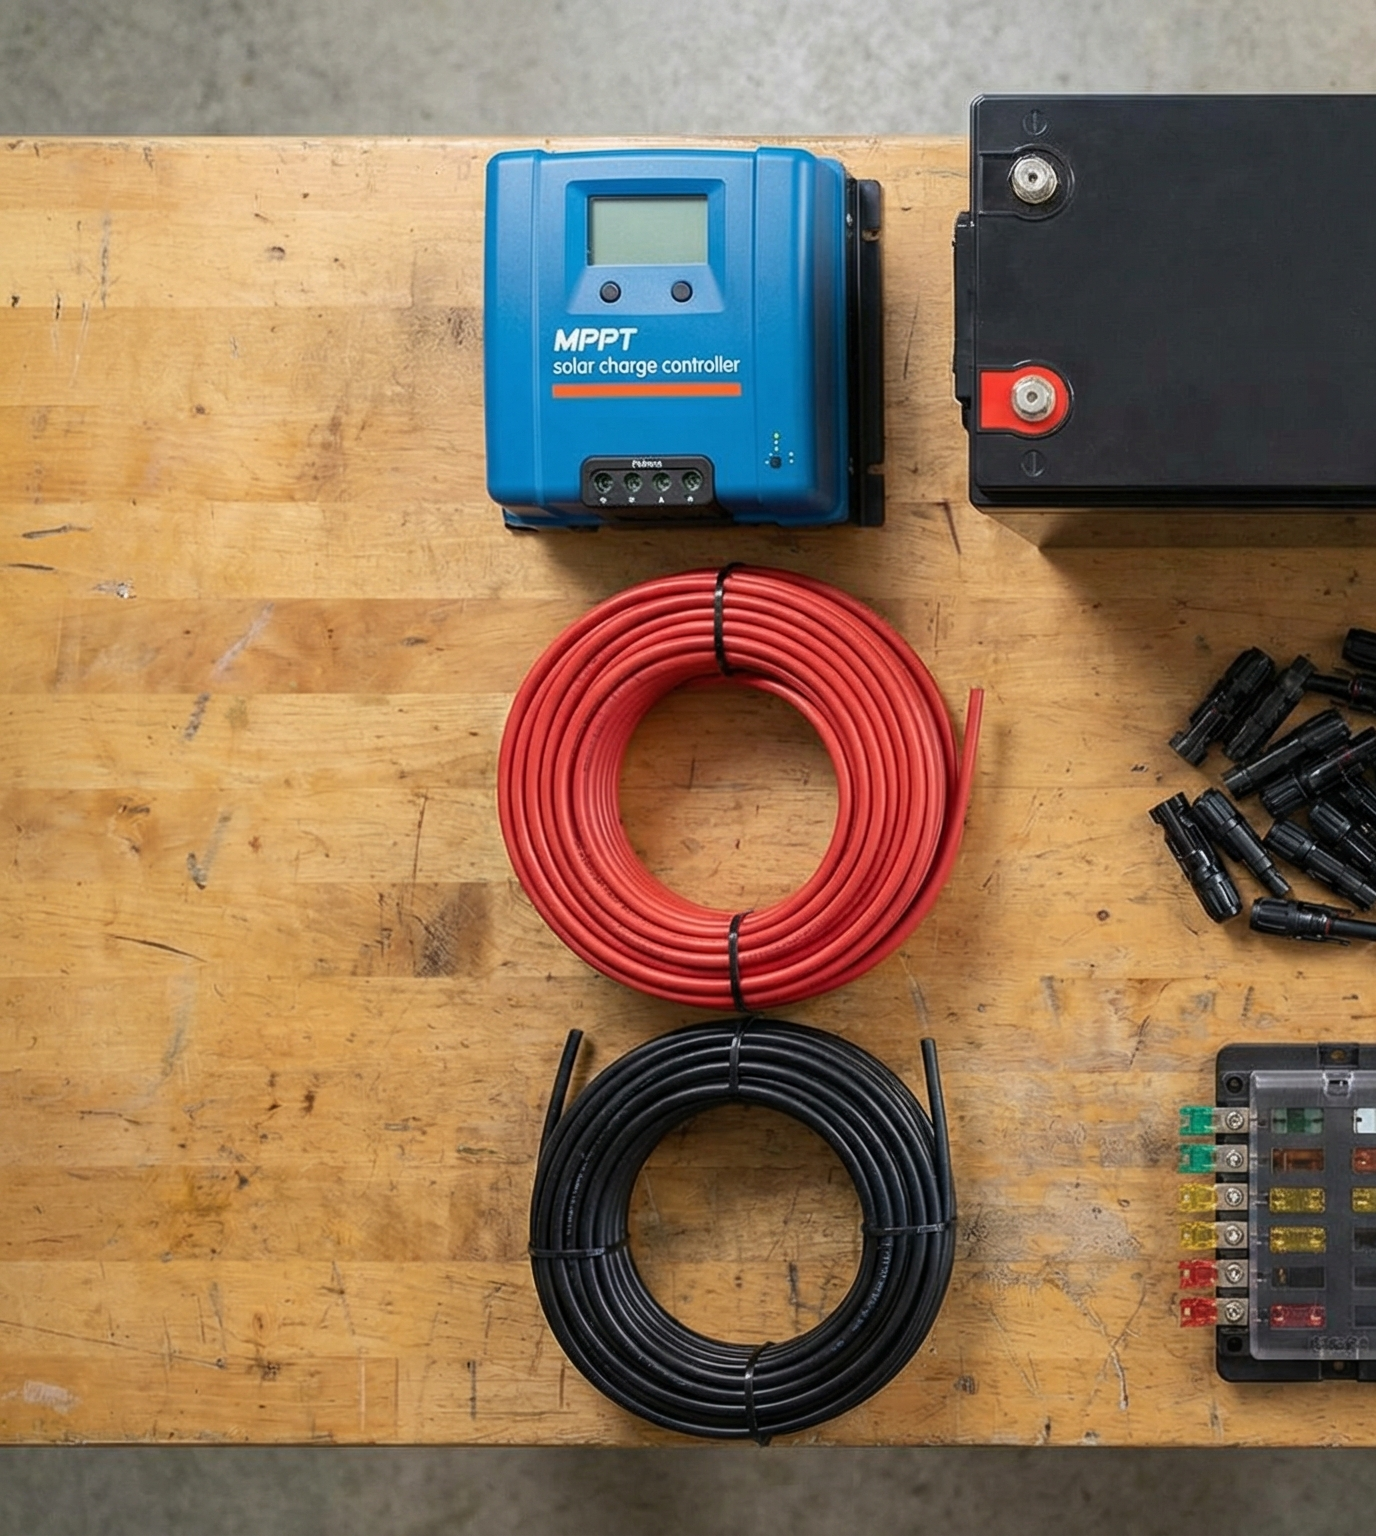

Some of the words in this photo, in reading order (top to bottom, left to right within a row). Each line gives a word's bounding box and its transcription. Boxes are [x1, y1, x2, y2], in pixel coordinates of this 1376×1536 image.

[553, 327, 638, 352] MPPT
[553, 356, 596, 375] solar
[599, 356, 658, 378] charge
[661, 355, 741, 374] controller
